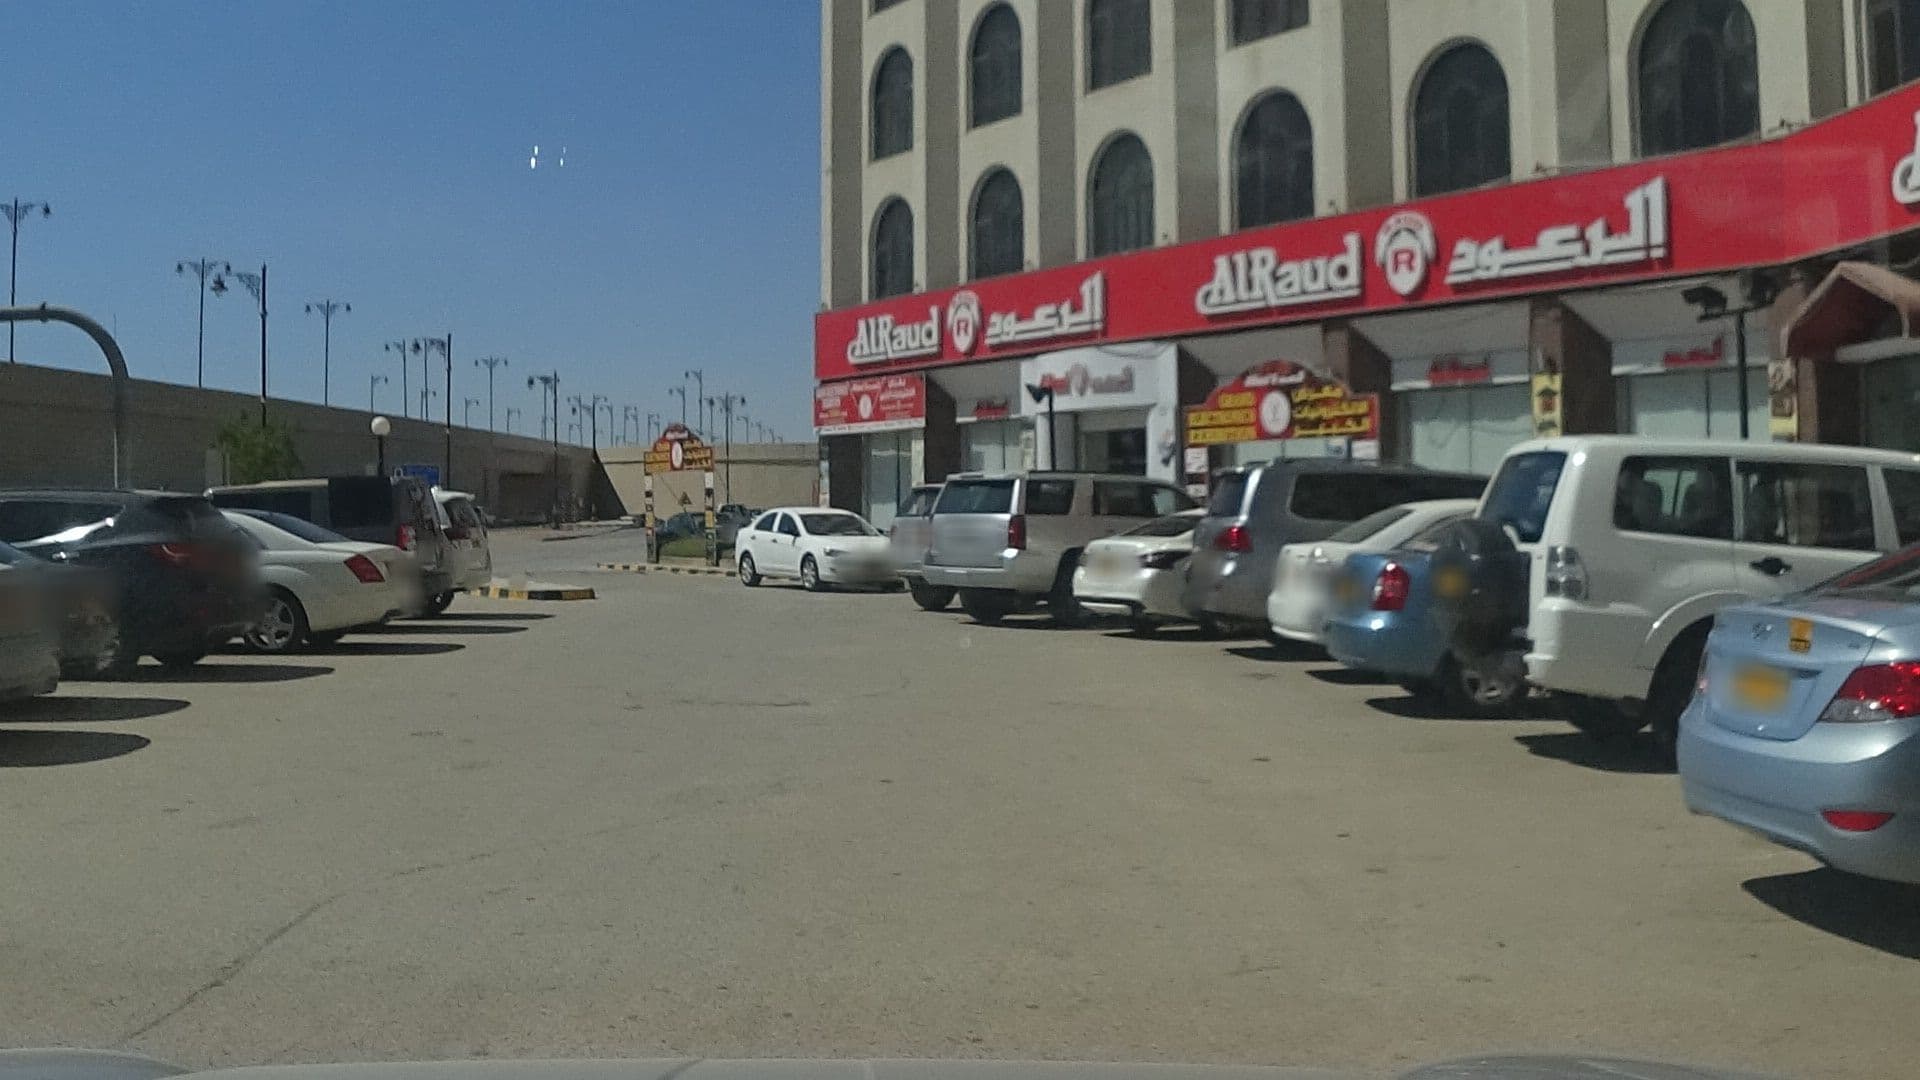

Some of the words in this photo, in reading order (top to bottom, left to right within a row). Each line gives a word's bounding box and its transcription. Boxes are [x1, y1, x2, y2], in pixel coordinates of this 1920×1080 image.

[1392, 248, 1415, 274] R
[1445, 177, 1666, 285] الرعود
[985, 272, 1104, 343] الرعود
[1195, 233, 1361, 316] AlRaud
[847, 306, 938, 364] AlRaud
